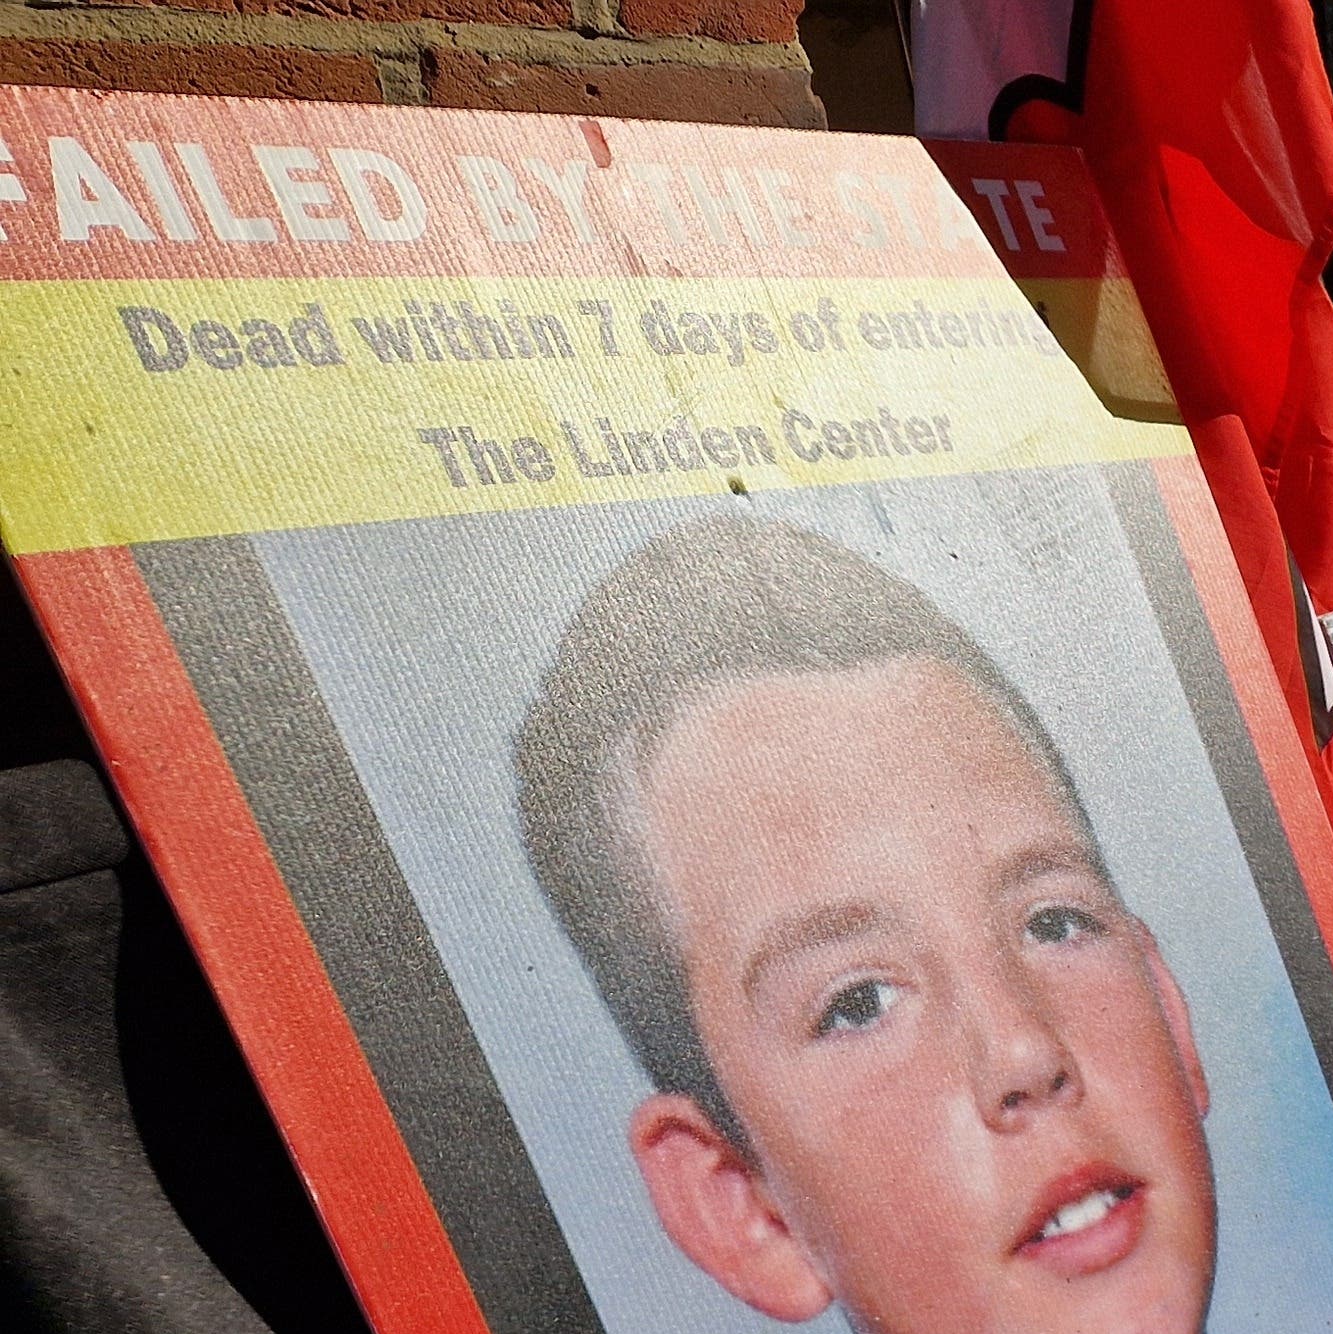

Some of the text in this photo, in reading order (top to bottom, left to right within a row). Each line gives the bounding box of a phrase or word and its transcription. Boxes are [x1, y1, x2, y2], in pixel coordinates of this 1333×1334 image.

[0, 136, 1066, 253] AILED BY THE STATE
[118, 296, 1066, 374] Dead within 7 days of entering
[417, 406, 954, 488] The Linden Center
